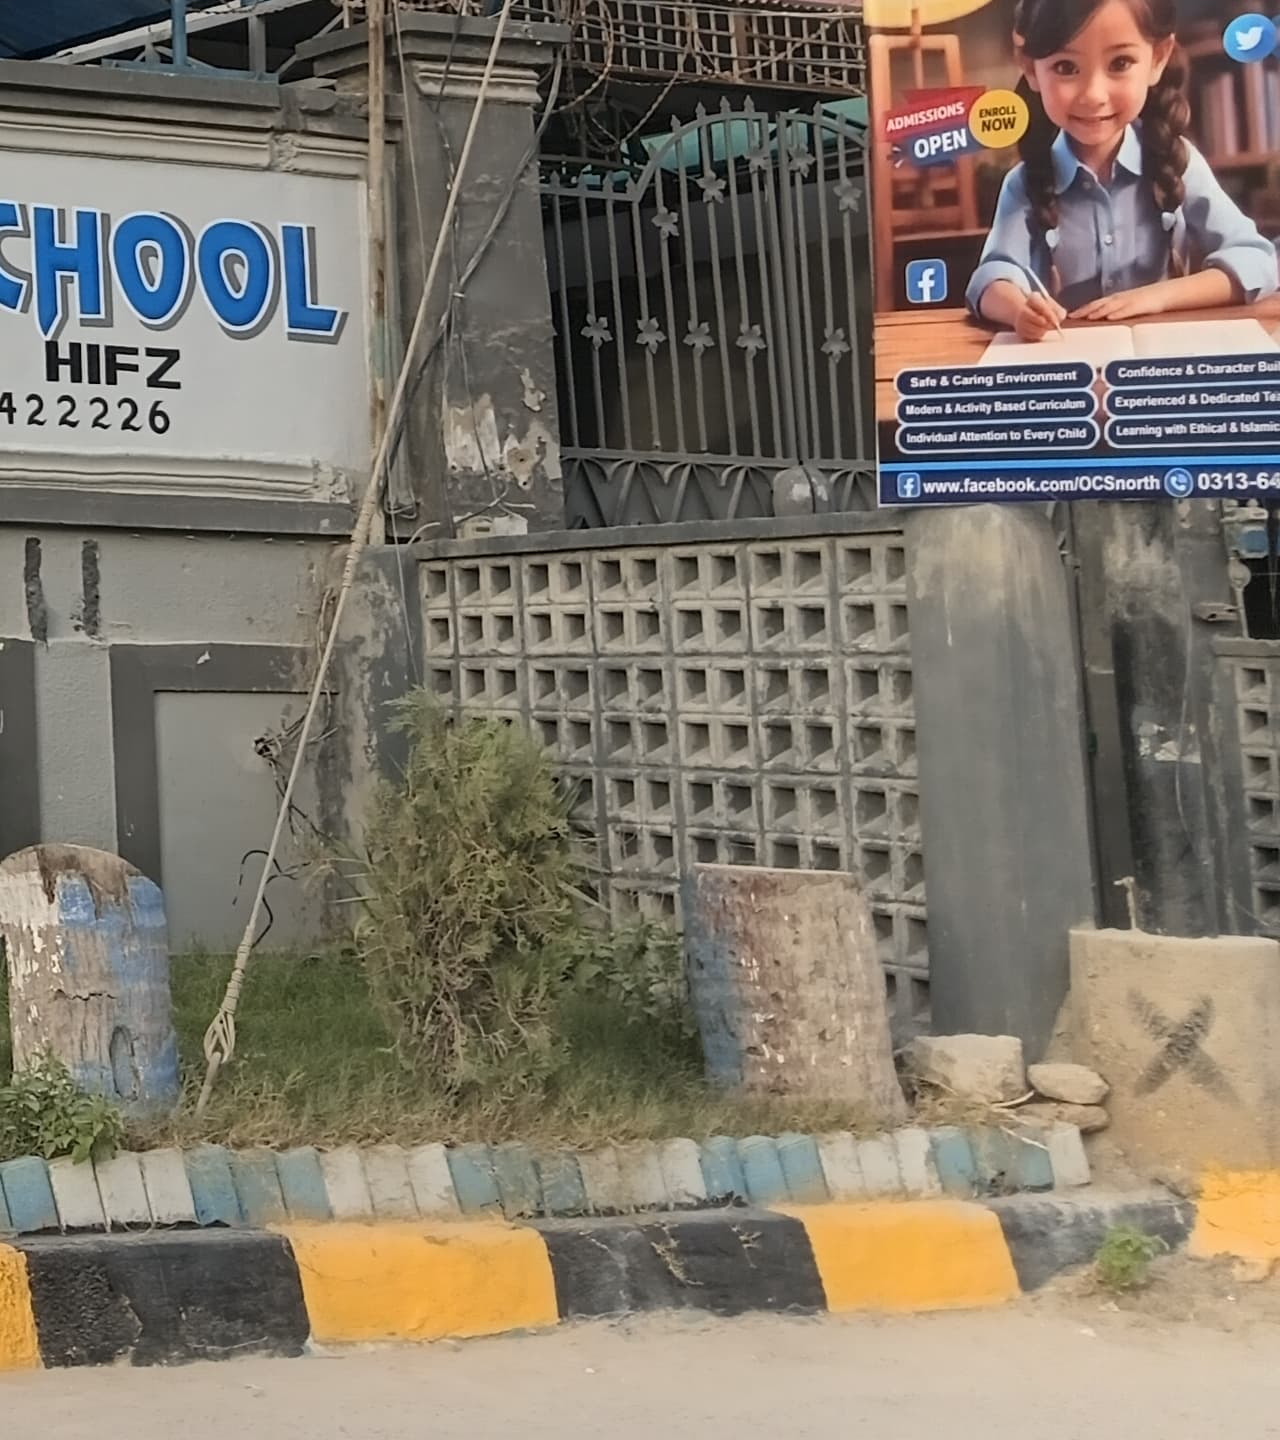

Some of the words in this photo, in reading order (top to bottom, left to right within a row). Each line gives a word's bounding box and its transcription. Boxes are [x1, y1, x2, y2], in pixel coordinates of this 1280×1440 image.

[886, 102, 966, 132] ADMISSIONS
[979, 106, 1017, 118] ENROLL
[981, 117, 1016, 133] NOW
[914, 128, 968, 158] OPEN
[44, 340, 182, 390] HIFZ
[1118, 365, 1183, 379] Confidence
[1185, 364, 1195, 376] &
[1197, 362, 1256, 375] Character
[910, 376, 937, 388] Safe
[939, 376, 949, 387] &
[952, 373, 994, 387] Caring
[996, 370, 1077, 385] Environment
[905, 404, 942, 416] Modern
[944, 403, 953, 414] &
[954, 401, 992, 415] Activity
[994, 400, 1027, 412] Based
[1028, 398, 1086, 412] Curriculum
[1114, 393, 1186, 409] Experienced
[1188, 393, 1198, 405] &
[1200, 391, 1260, 404] Dedicated
[906, 431, 957, 444] Individual
[959, 429, 1009, 442] Attention
[1009, 430, 1022, 441] to
[1023, 428, 1055, 442] Every
[1057, 427, 1087, 440] Child
[1115, 423, 1163, 438] Learning
[1165, 423, 1188, 435] with
[1189, 421, 1227, 434] Ethical
[1229, 421, 1238, 433] &
[922, 473, 1161, 496] www.facebook.com/OCSnorth
